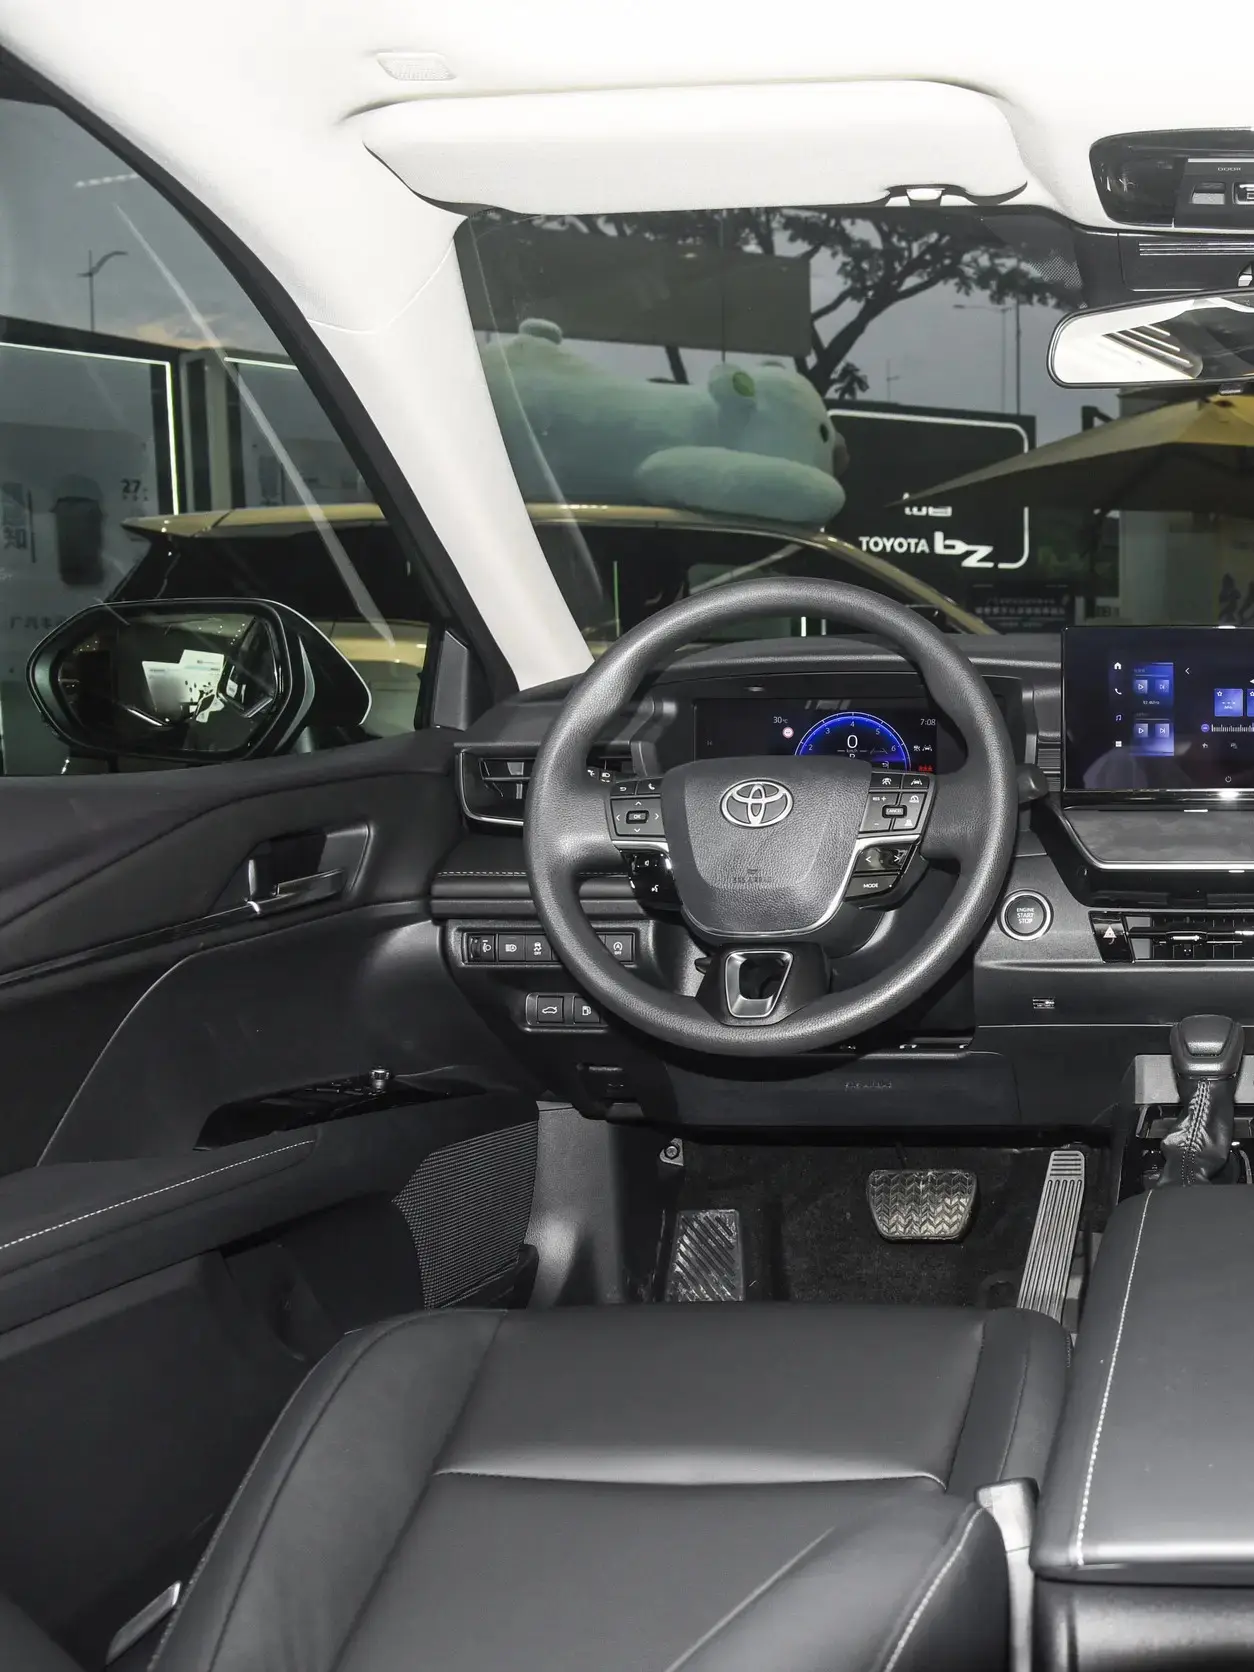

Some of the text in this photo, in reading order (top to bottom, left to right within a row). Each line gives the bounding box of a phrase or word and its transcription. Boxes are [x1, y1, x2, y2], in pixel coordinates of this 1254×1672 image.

[859, 536, 930, 553] TOYOTA
[920, 718, 936, 726] 7:08
[847, 734, 858, 749] 0
